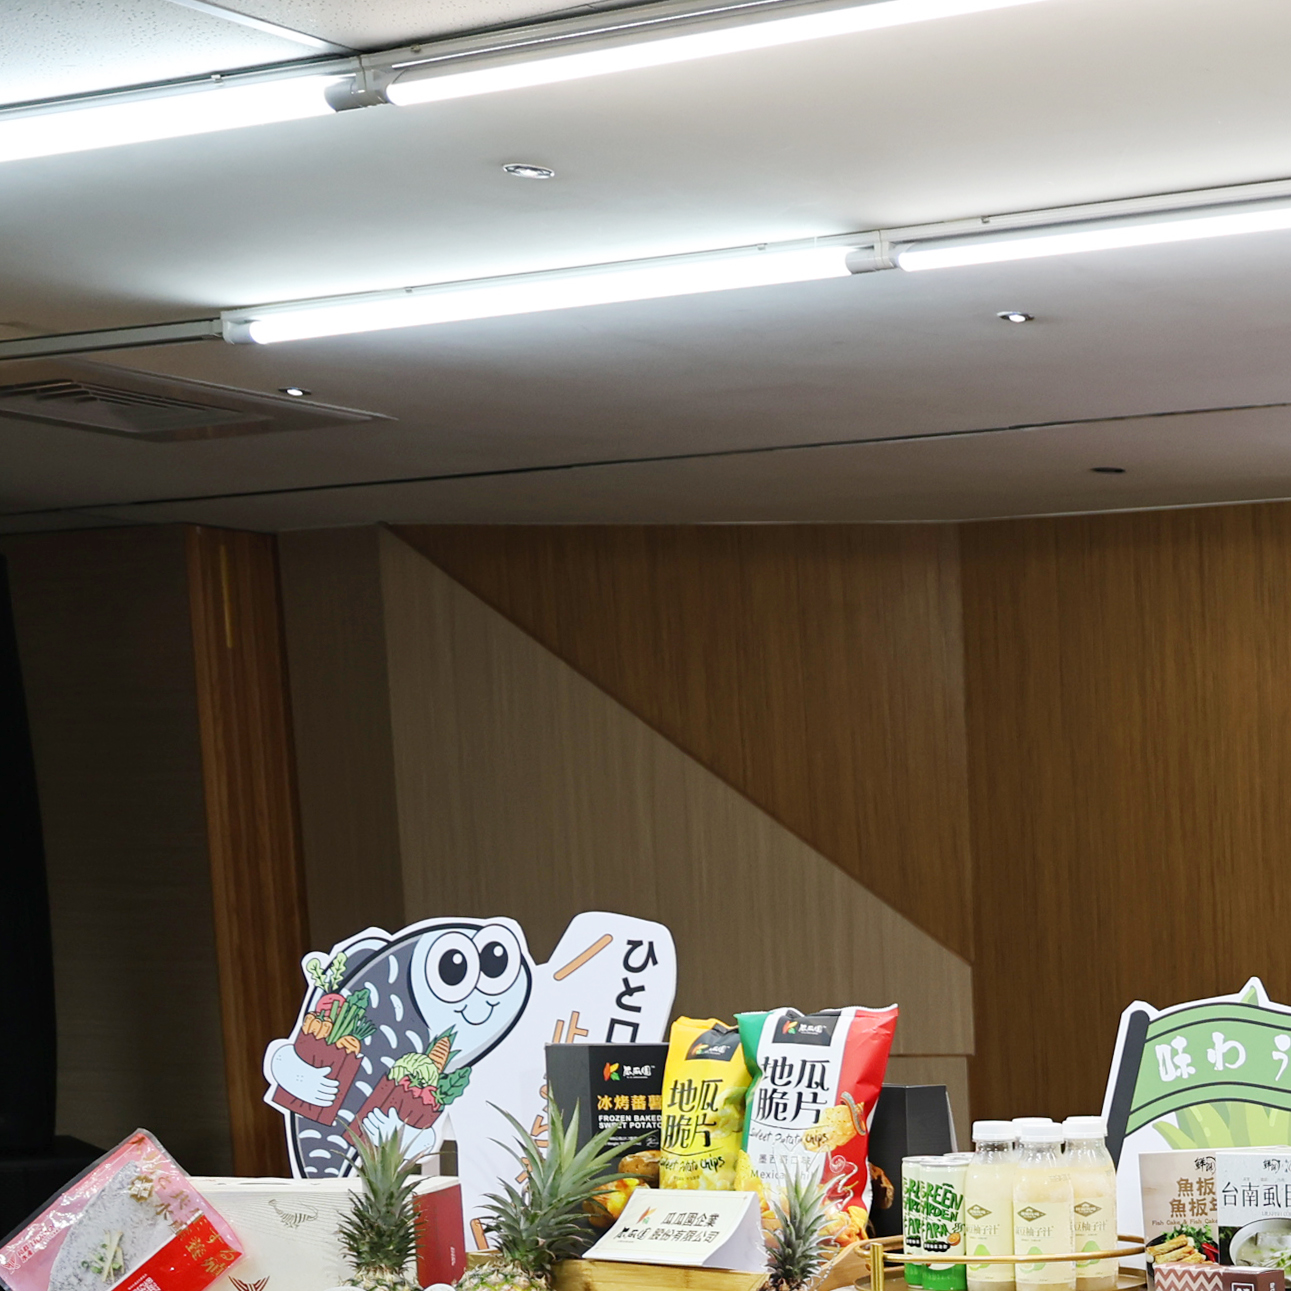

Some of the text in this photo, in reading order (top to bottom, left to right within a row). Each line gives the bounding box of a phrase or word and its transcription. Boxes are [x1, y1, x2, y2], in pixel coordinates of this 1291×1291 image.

[761, 1057, 830, 1091] 地瓜
[667, 1079, 722, 1113] 地瓜
[757, 1089, 827, 1123] 脆片
[664, 1114, 717, 1149] 脆片
[649, 1228, 720, 1243] 股份有限公司
